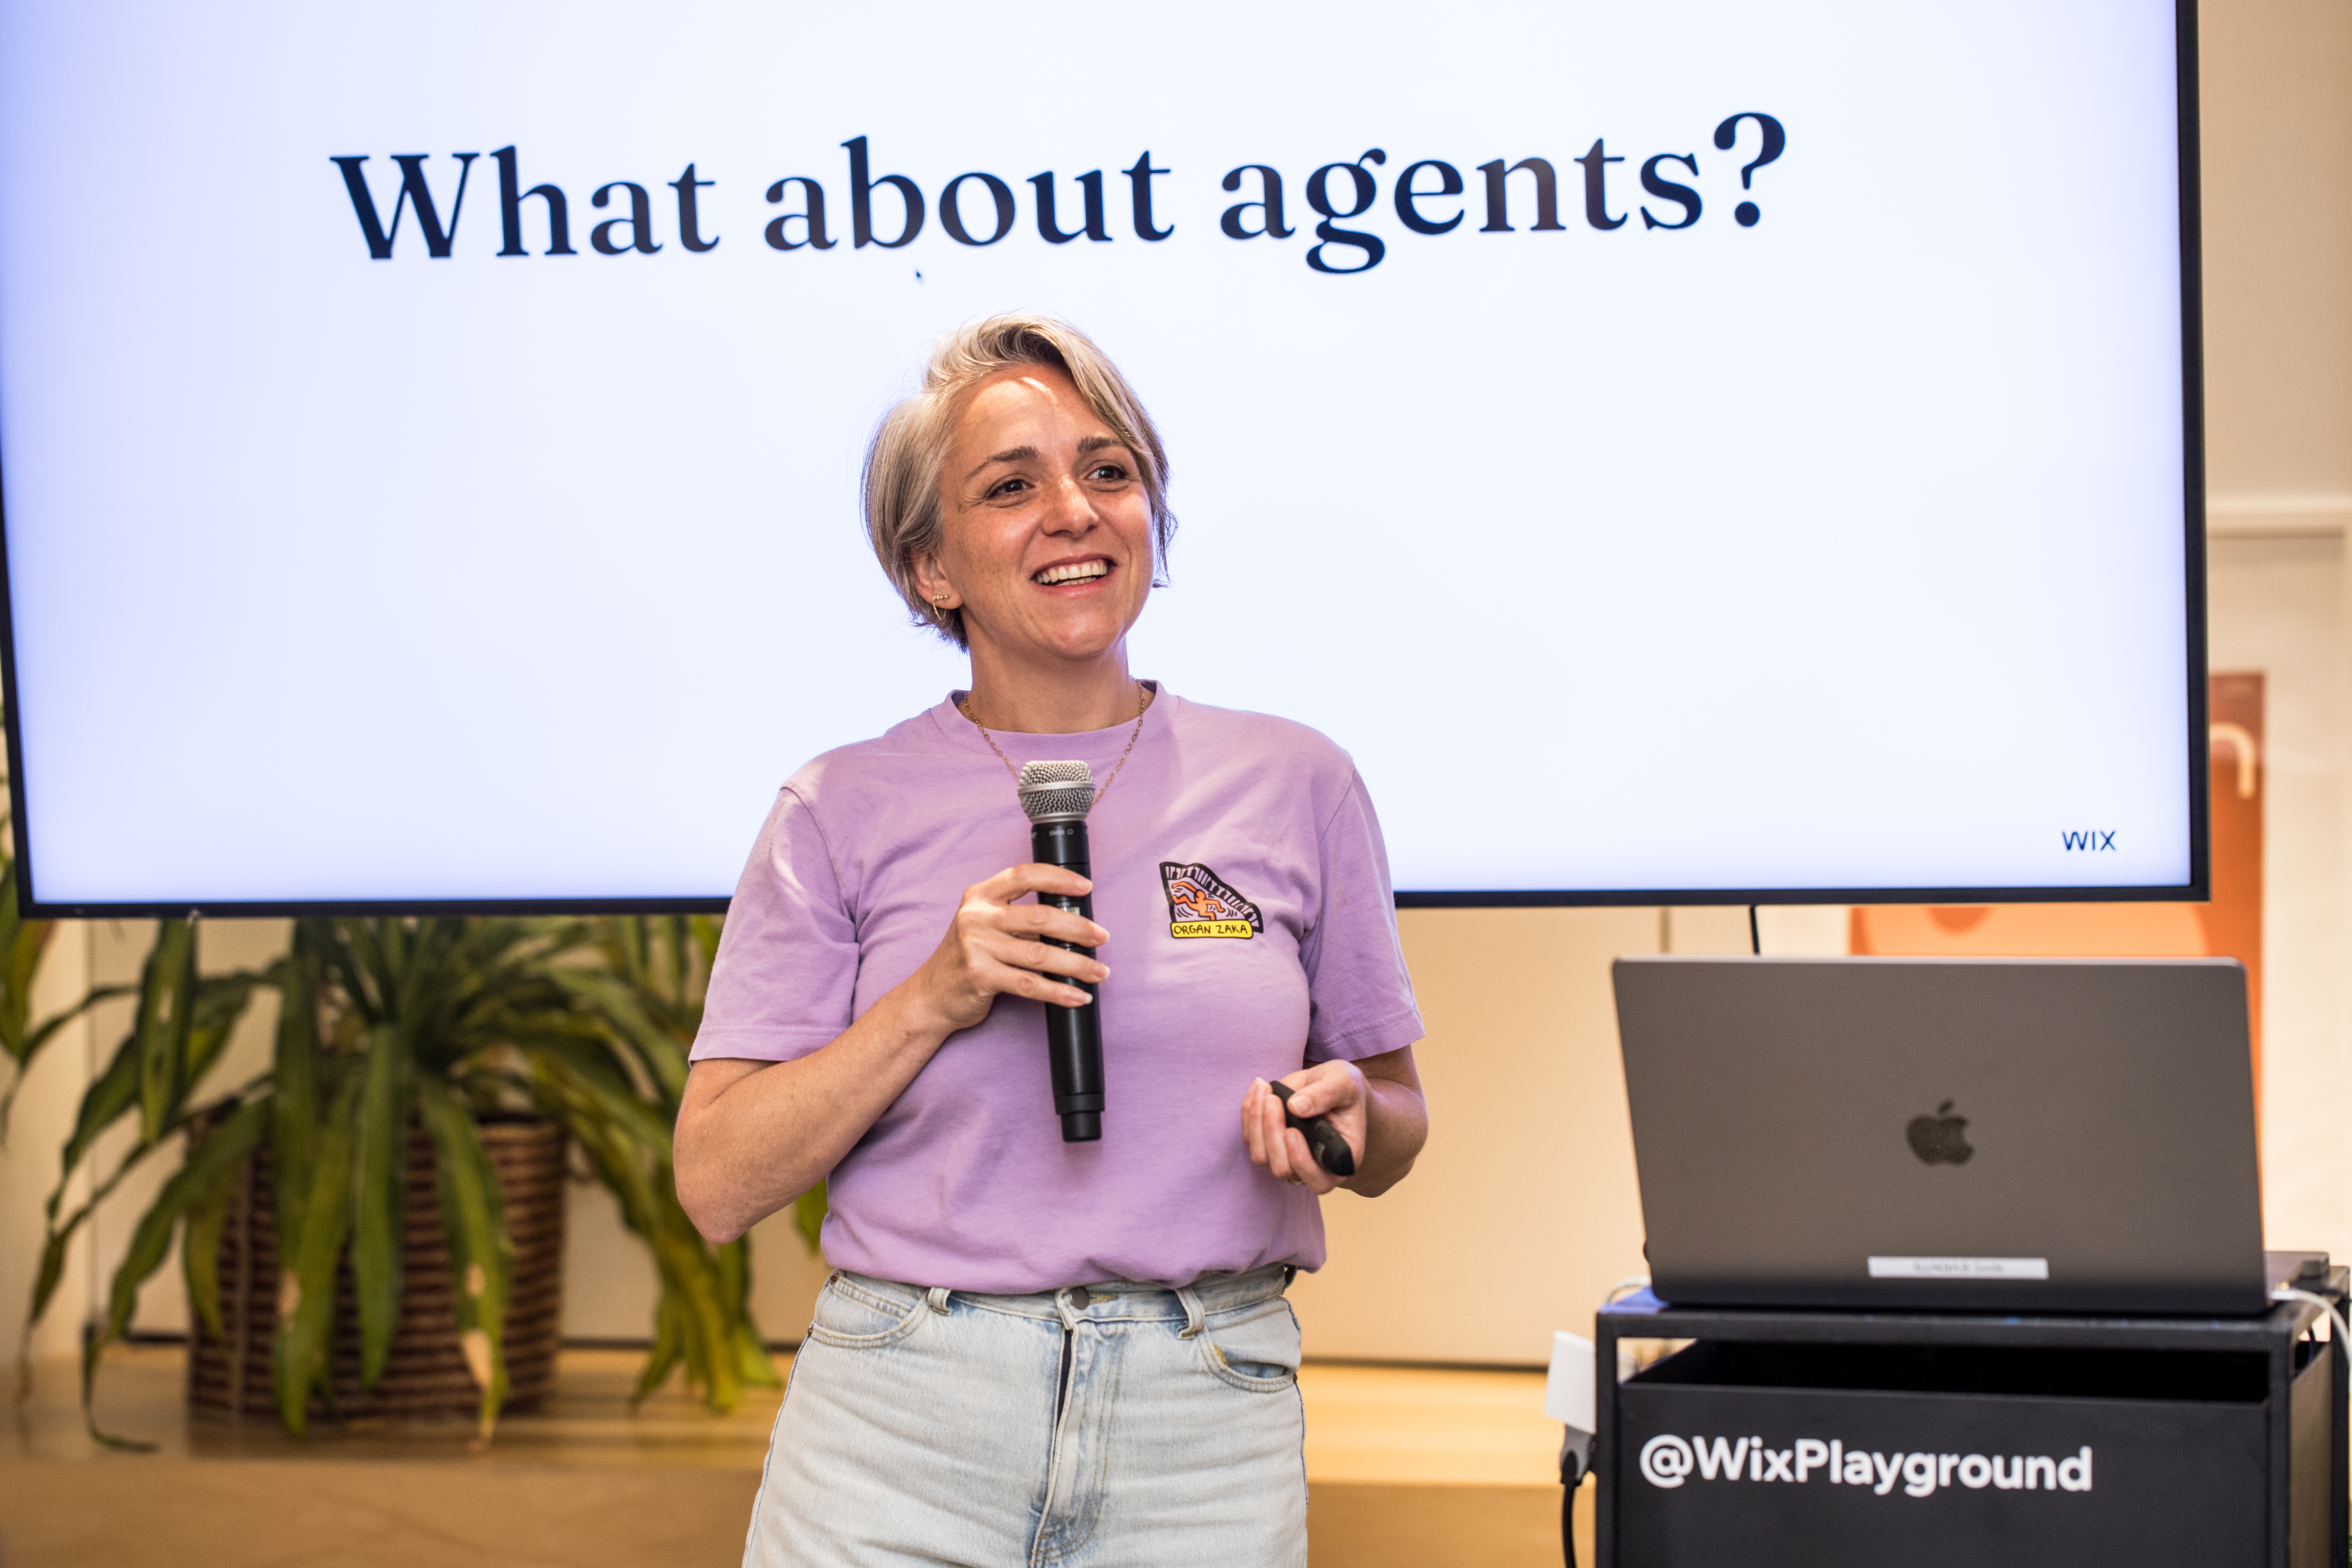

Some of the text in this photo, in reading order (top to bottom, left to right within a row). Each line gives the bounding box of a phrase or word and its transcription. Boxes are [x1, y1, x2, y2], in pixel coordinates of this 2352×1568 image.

[329, 112, 1786, 274] What about agents?
[2062, 831, 2116, 851] WIX
[1173, 925, 1248, 935] ORGAN ZAKA
[1639, 1434, 2092, 1497] @WixPlayground
